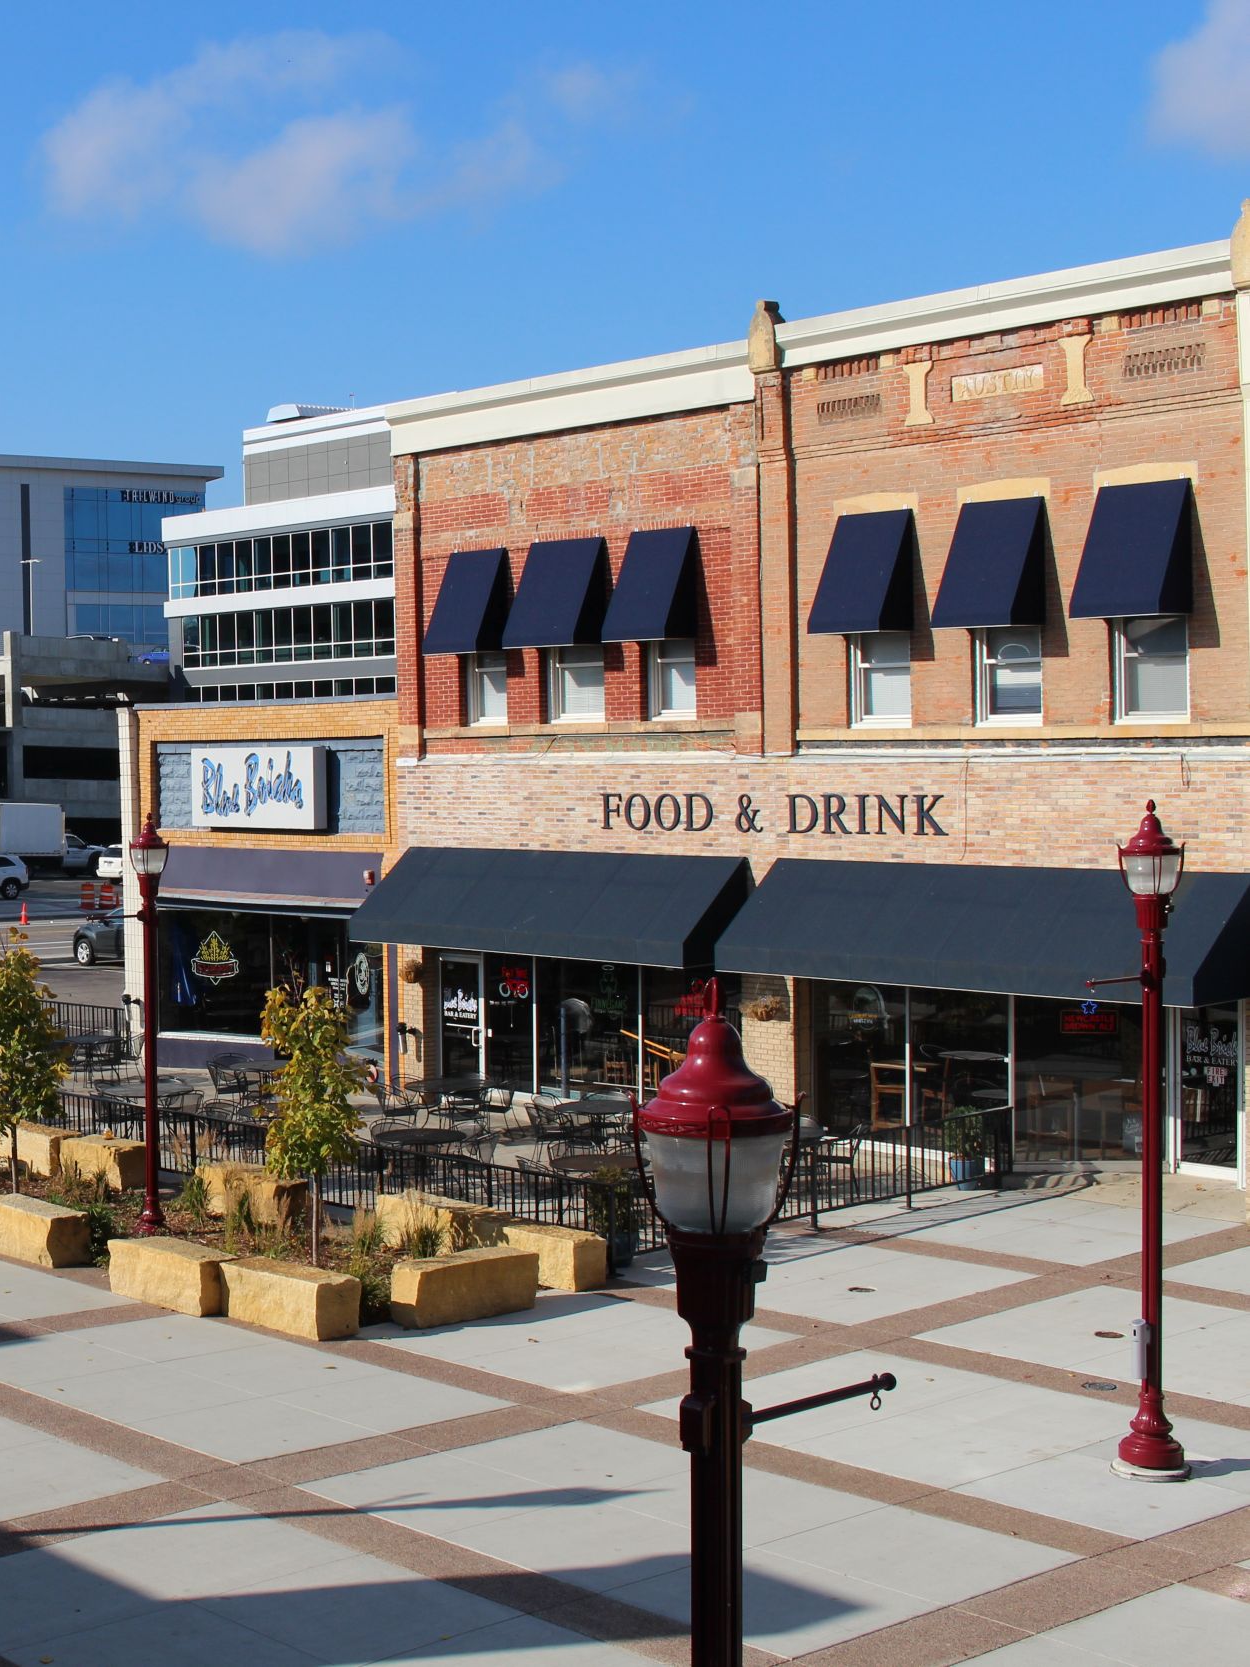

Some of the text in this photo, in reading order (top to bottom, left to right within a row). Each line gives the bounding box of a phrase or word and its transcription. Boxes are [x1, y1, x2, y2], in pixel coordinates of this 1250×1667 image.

[954, 367, 1035, 398] AUSTIN
[125, 489, 174, 503] TAILWIND
[201, 750, 303, 817] Blue Bricks
[600, 793, 949, 836] FOOD & DRINK
[1186, 1026, 1209, 1054] Blue
[1186, 1055, 1202, 1063] BAR
[1207, 1067, 1225, 1075] FIRE
[1207, 1075, 1225, 1085] EXIT
